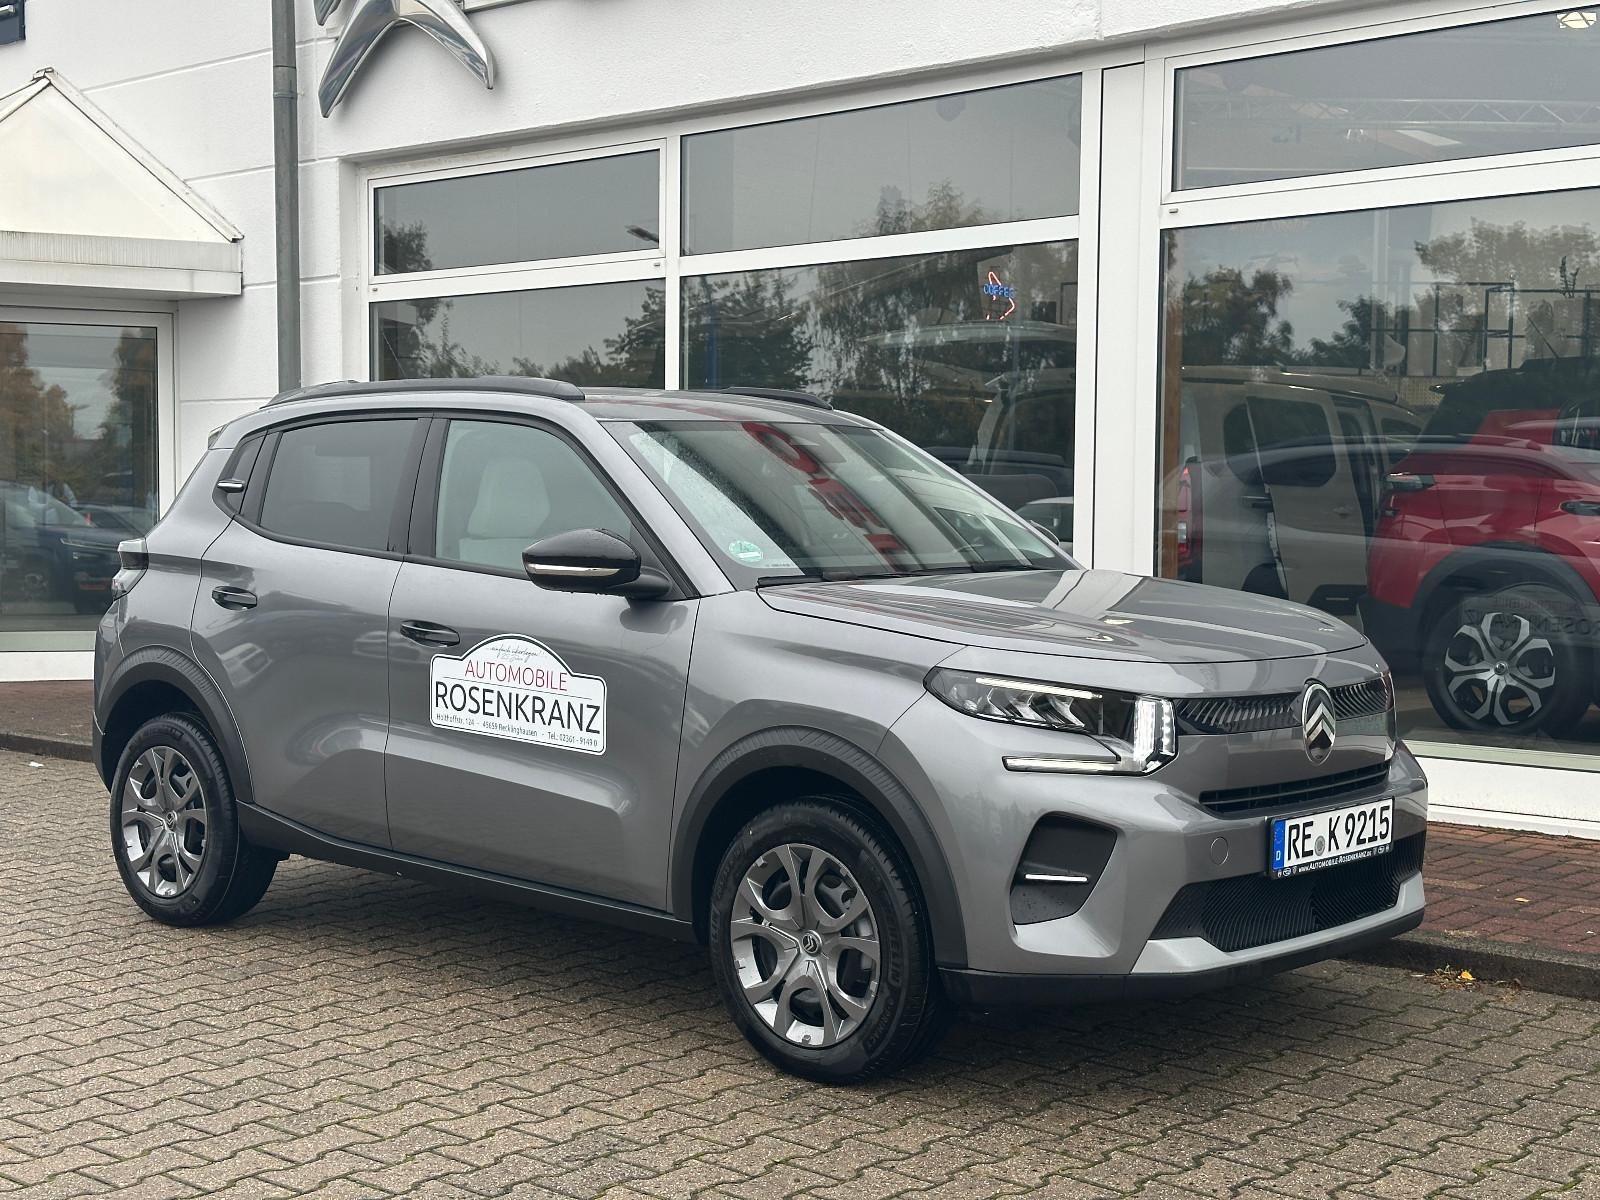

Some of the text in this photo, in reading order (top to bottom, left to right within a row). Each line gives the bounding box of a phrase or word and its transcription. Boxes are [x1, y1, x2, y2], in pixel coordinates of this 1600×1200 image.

[465, 660, 567, 691] AUTOMOBILE
[436, 682, 600, 734] ROSENKRANZ
[483, 720, 498, 731] 45659
[498, 723, 538, 738] Recklinghausen
[559, 733, 576, 744] 02361
[1287, 805, 1390, 861] RE K 9215
